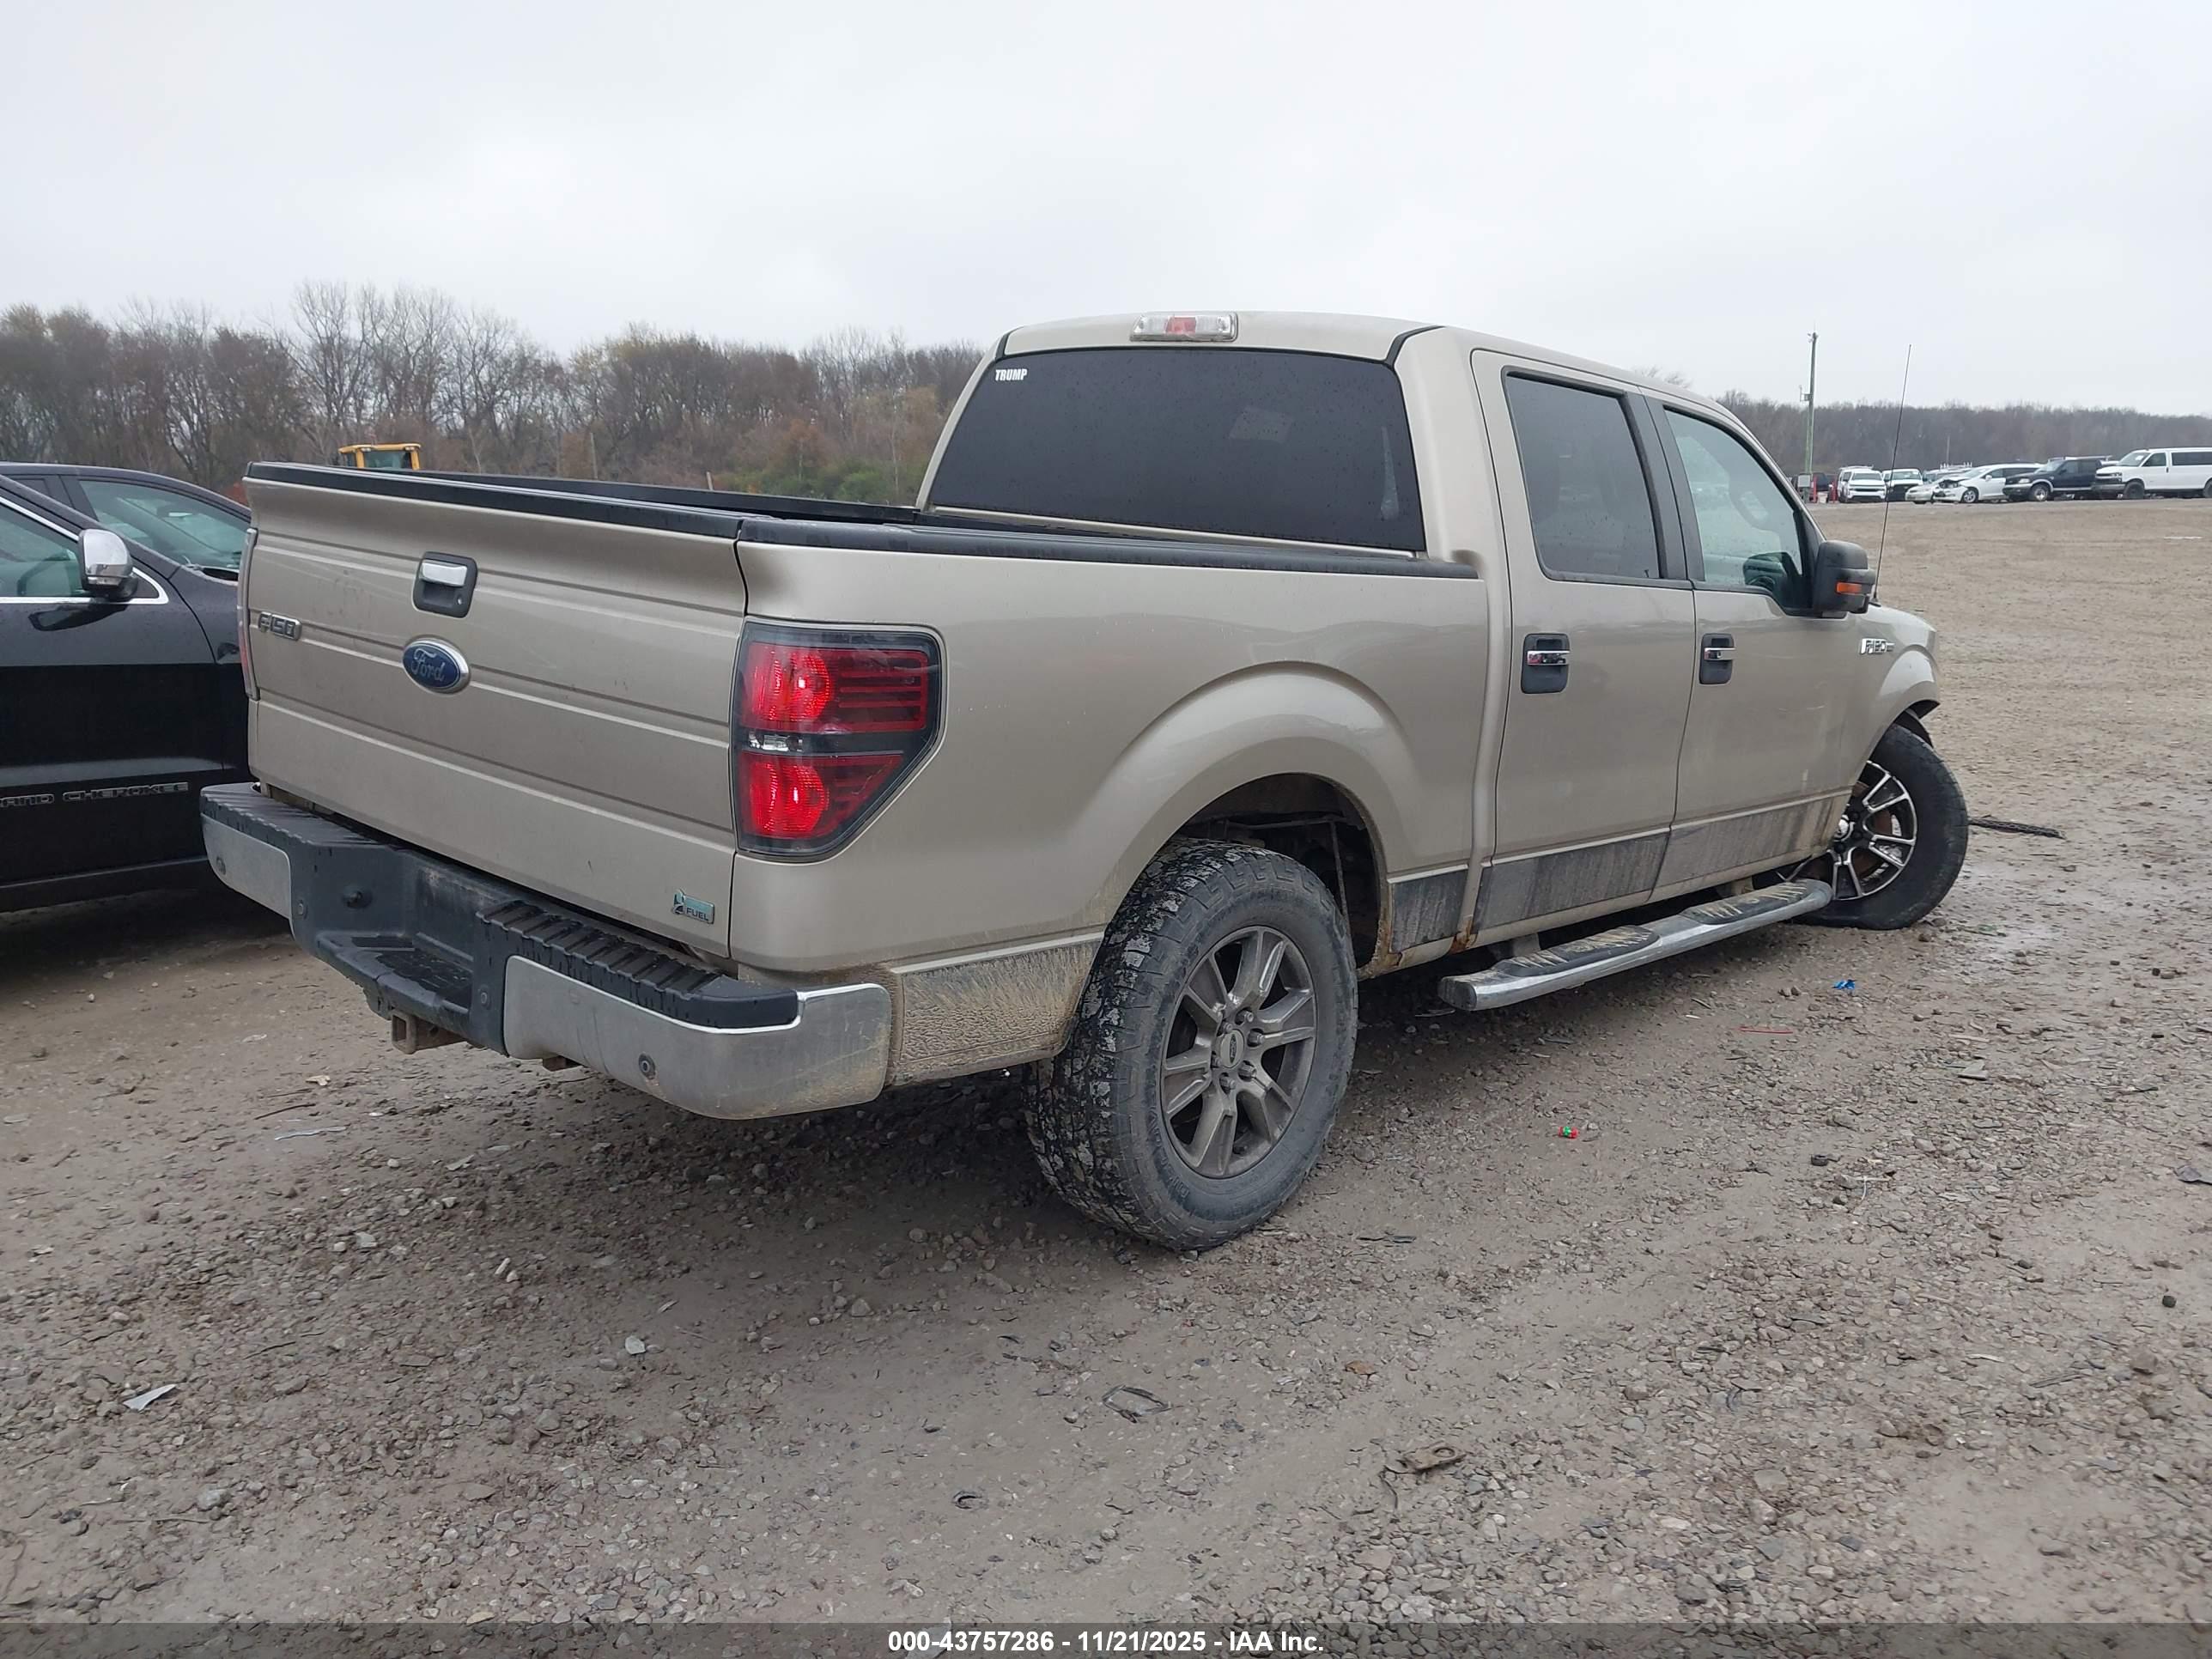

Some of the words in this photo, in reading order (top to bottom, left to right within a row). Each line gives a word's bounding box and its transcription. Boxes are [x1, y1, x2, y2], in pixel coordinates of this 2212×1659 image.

[995, 368, 1028, 381] TRUMP
[411, 647, 446, 682] Ford
[63, 781, 188, 802] CHEROKEE
[686, 907, 709, 921] FUEL
